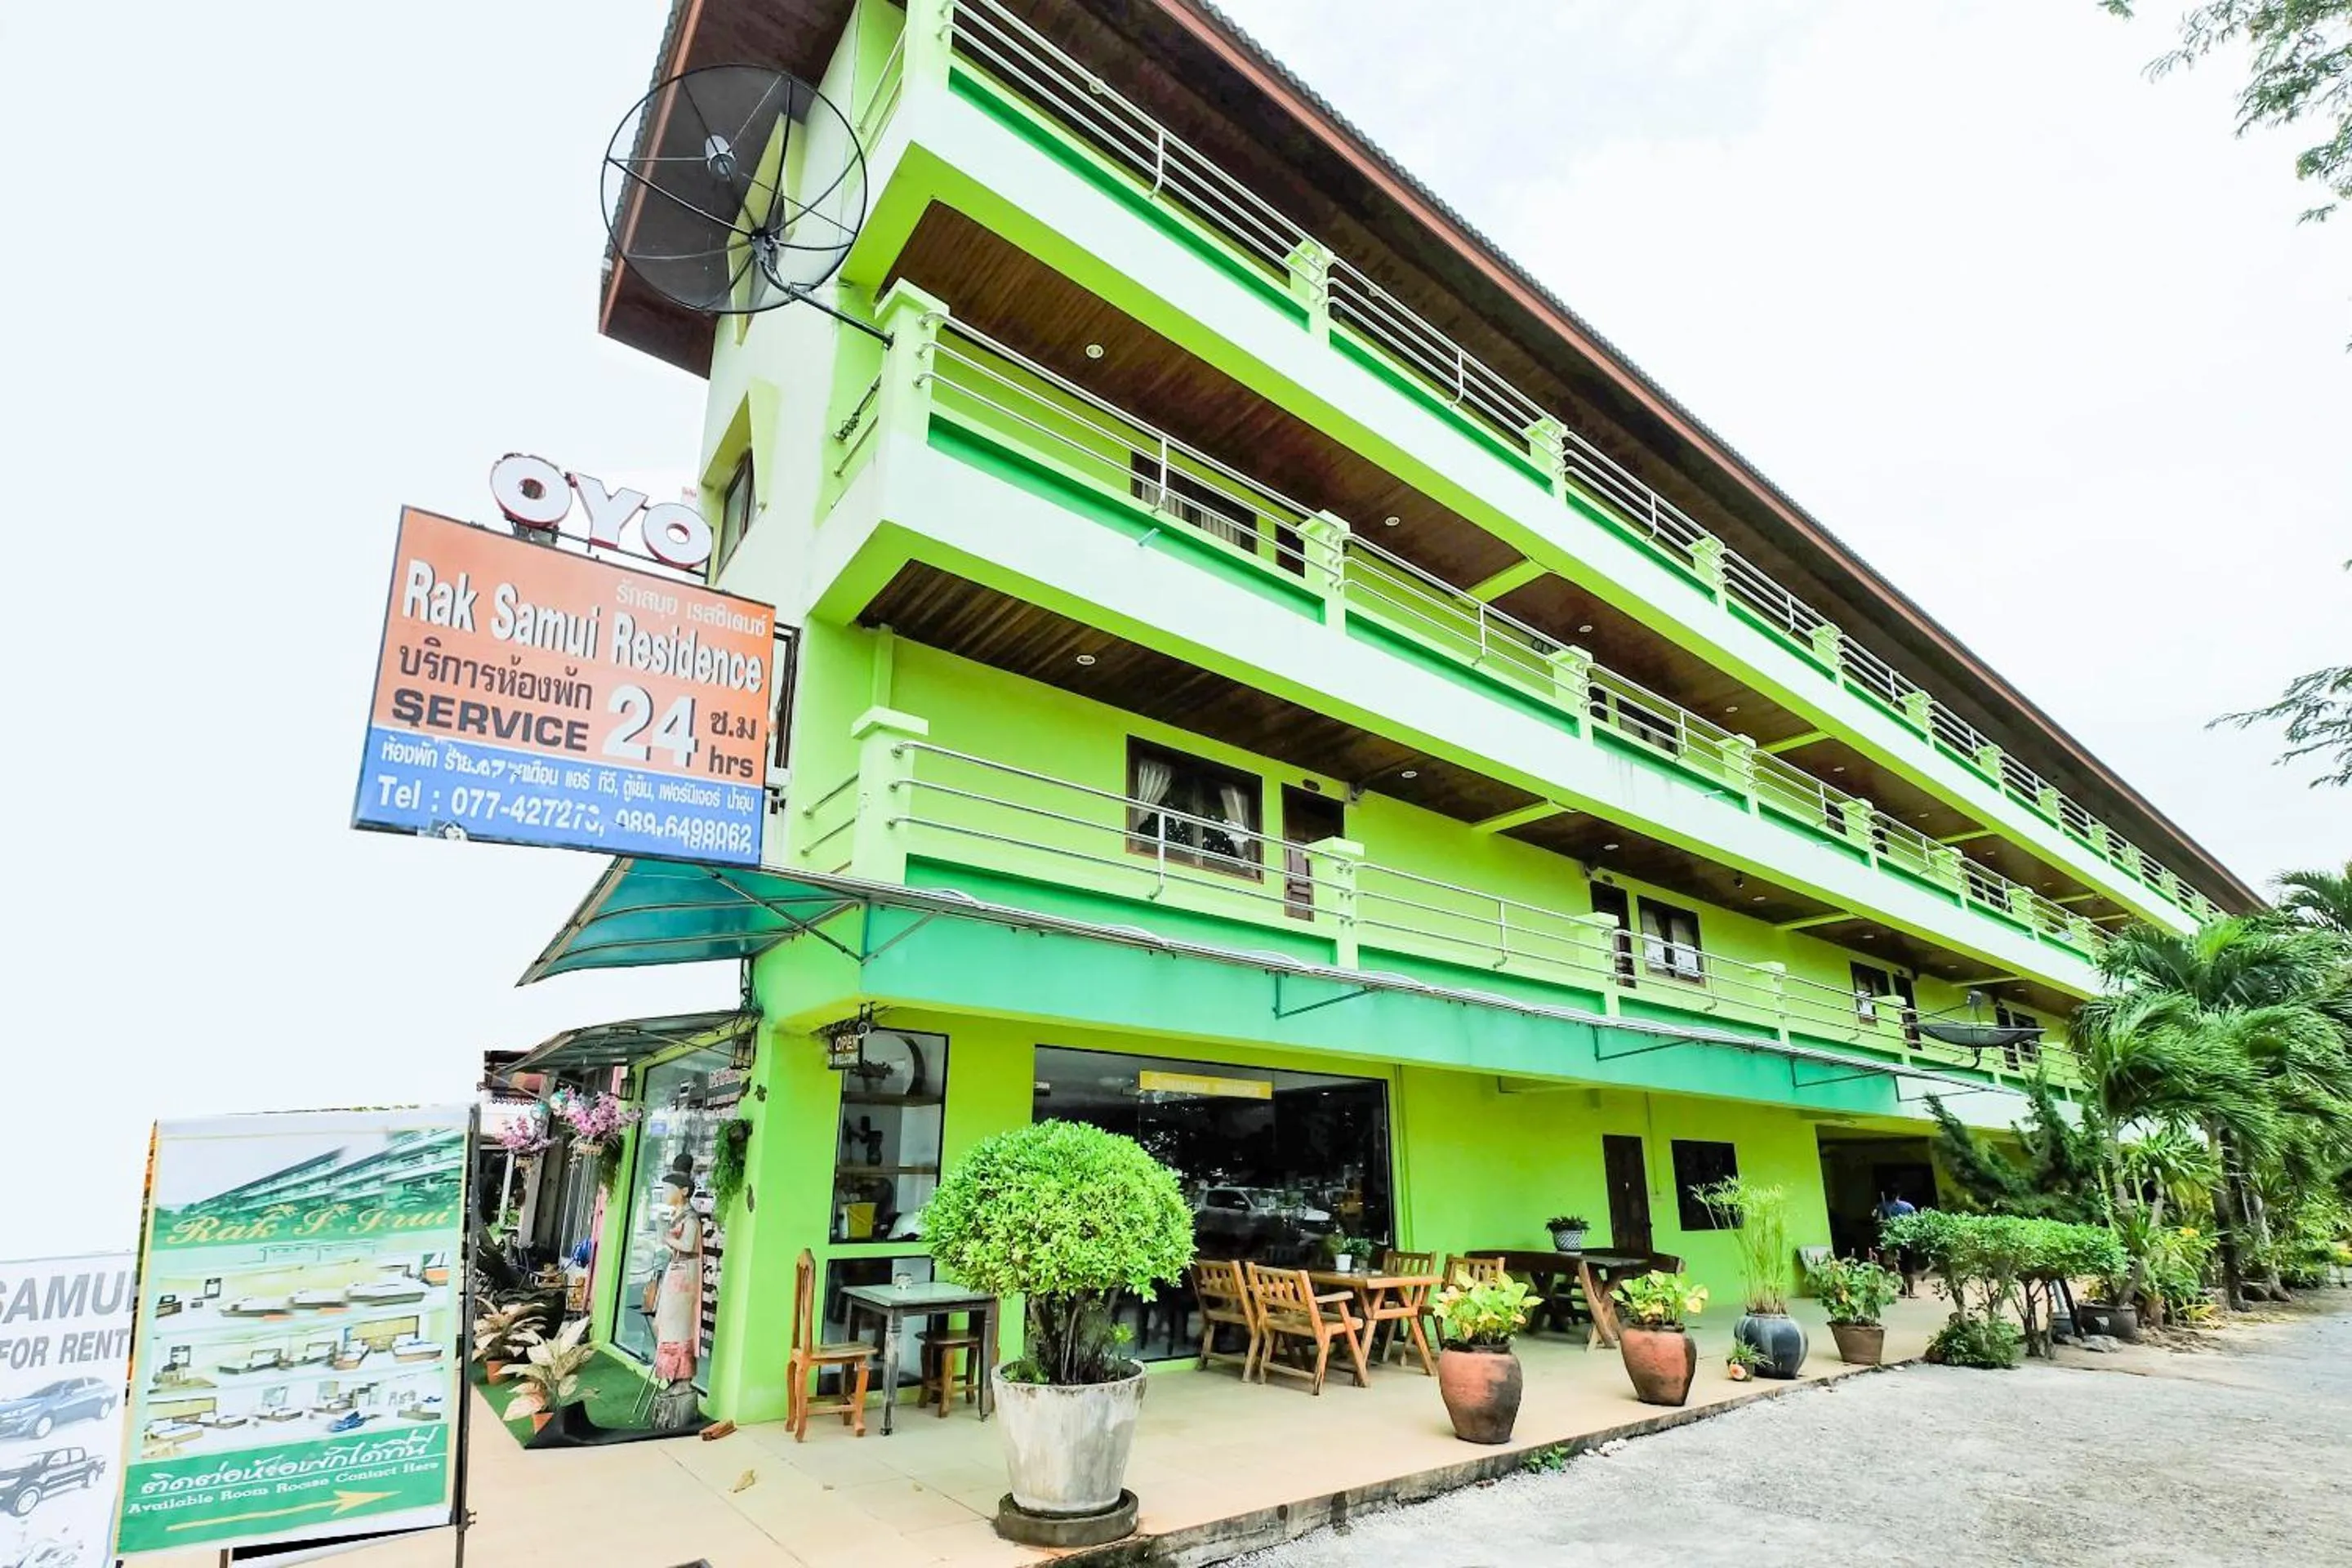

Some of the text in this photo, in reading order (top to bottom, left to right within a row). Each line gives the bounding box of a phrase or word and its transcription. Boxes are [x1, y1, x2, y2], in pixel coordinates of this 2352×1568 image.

[491, 453, 713, 568] OYO
[403, 559, 763, 693] Rak Samui Residence
[392, 688, 754, 779] SERVICE hrs
[399, 636, 592, 710] บริการห้องพัก
[602, 684, 699, 768] 24
[377, 774, 422, 810] Tel
[0, 1271, 136, 1324] AMUI
[59, 1327, 131, 1365] RENT
